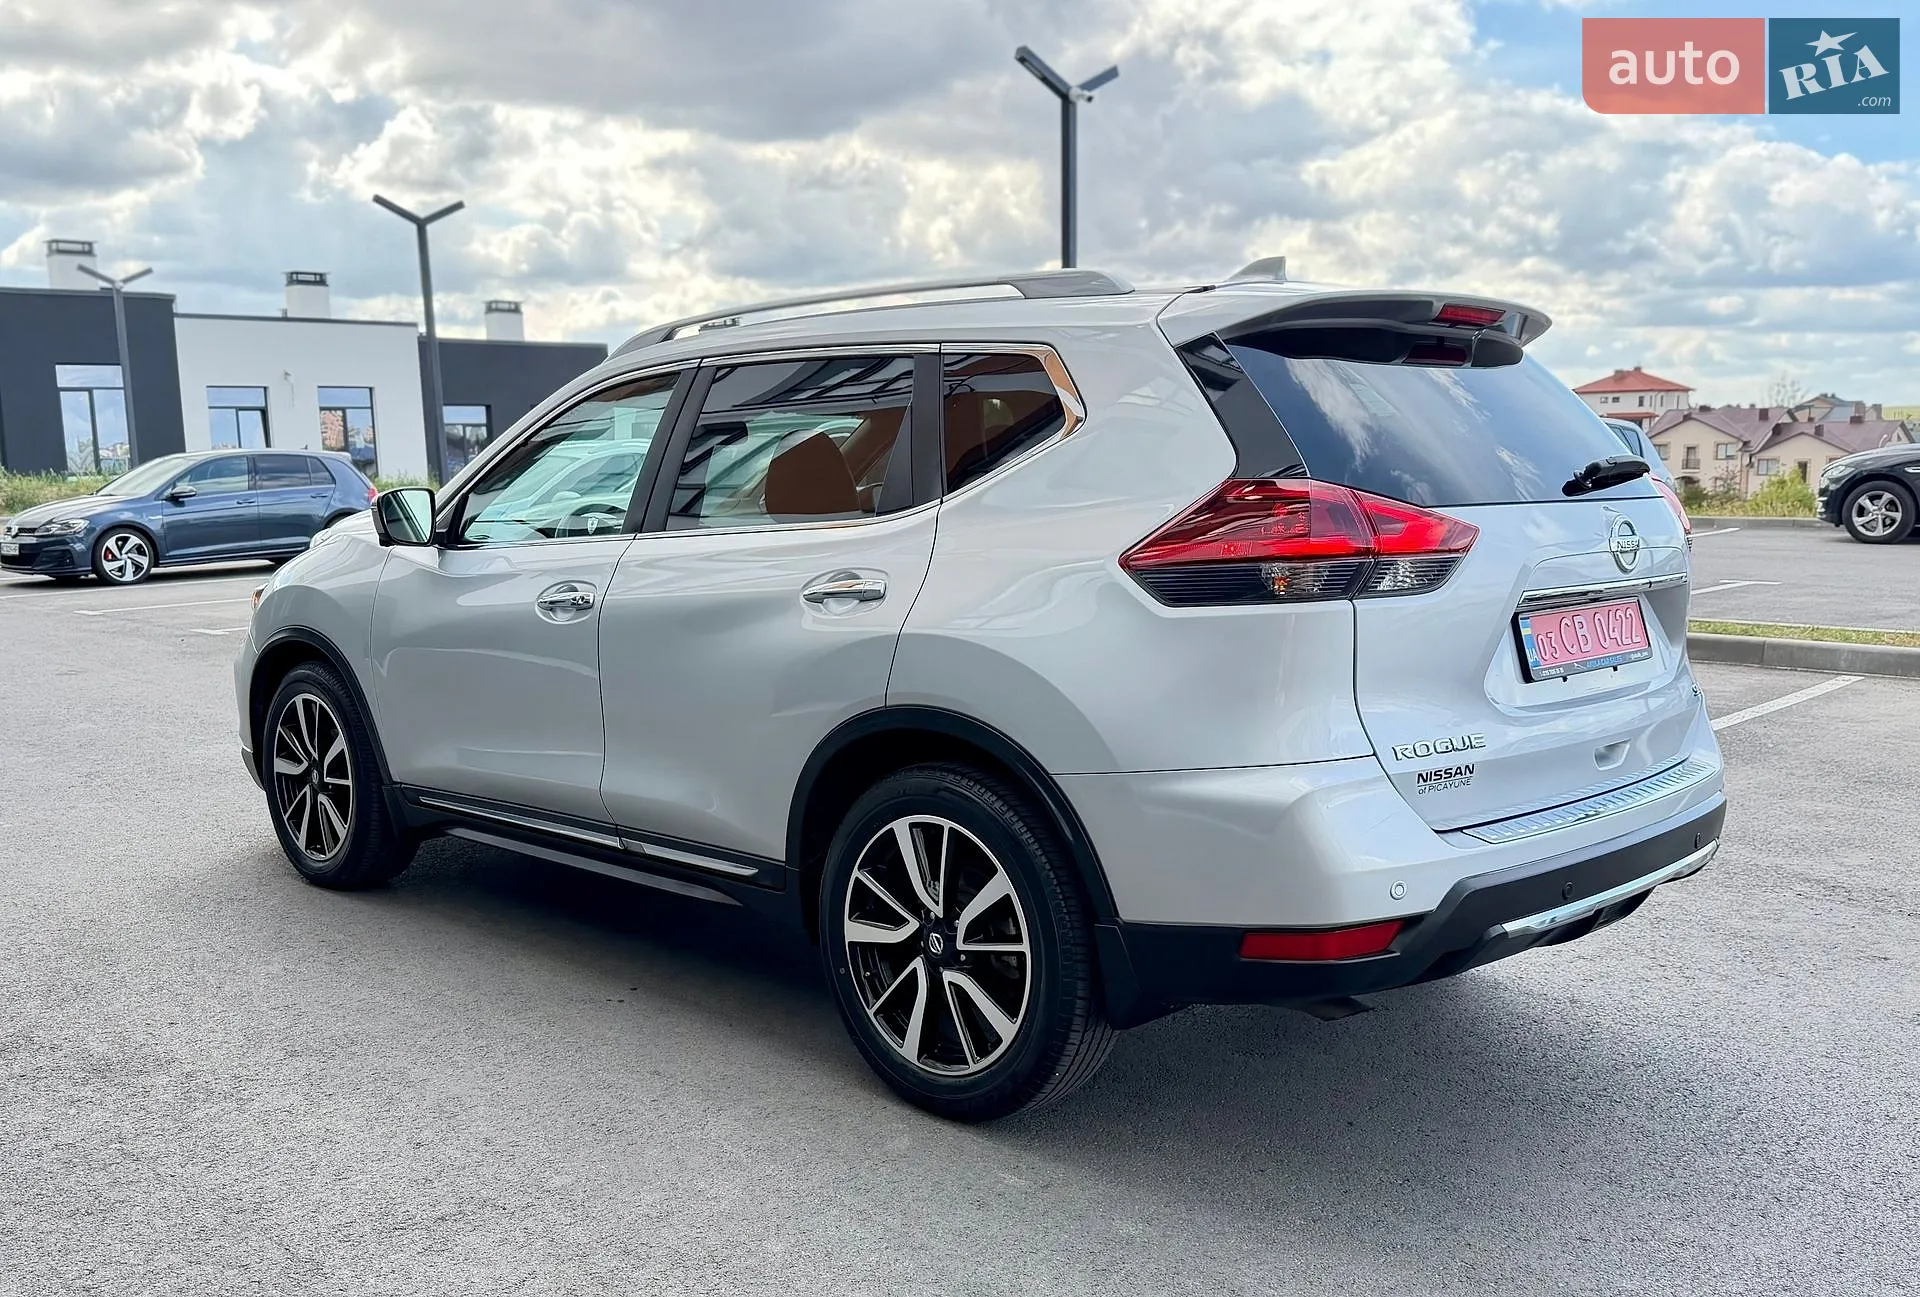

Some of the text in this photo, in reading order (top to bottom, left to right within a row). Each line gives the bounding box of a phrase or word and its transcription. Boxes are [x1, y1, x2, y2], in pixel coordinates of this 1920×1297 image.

[1536, 631, 1560, 662] 03
[1594, 606, 1642, 649] 0422
[1527, 647, 1539, 663] UA
[1391, 732, 1487, 761] ROGUE
[1416, 763, 1475, 785] NISSAN
[1418, 778, 1472, 795] of PICAYUNE
